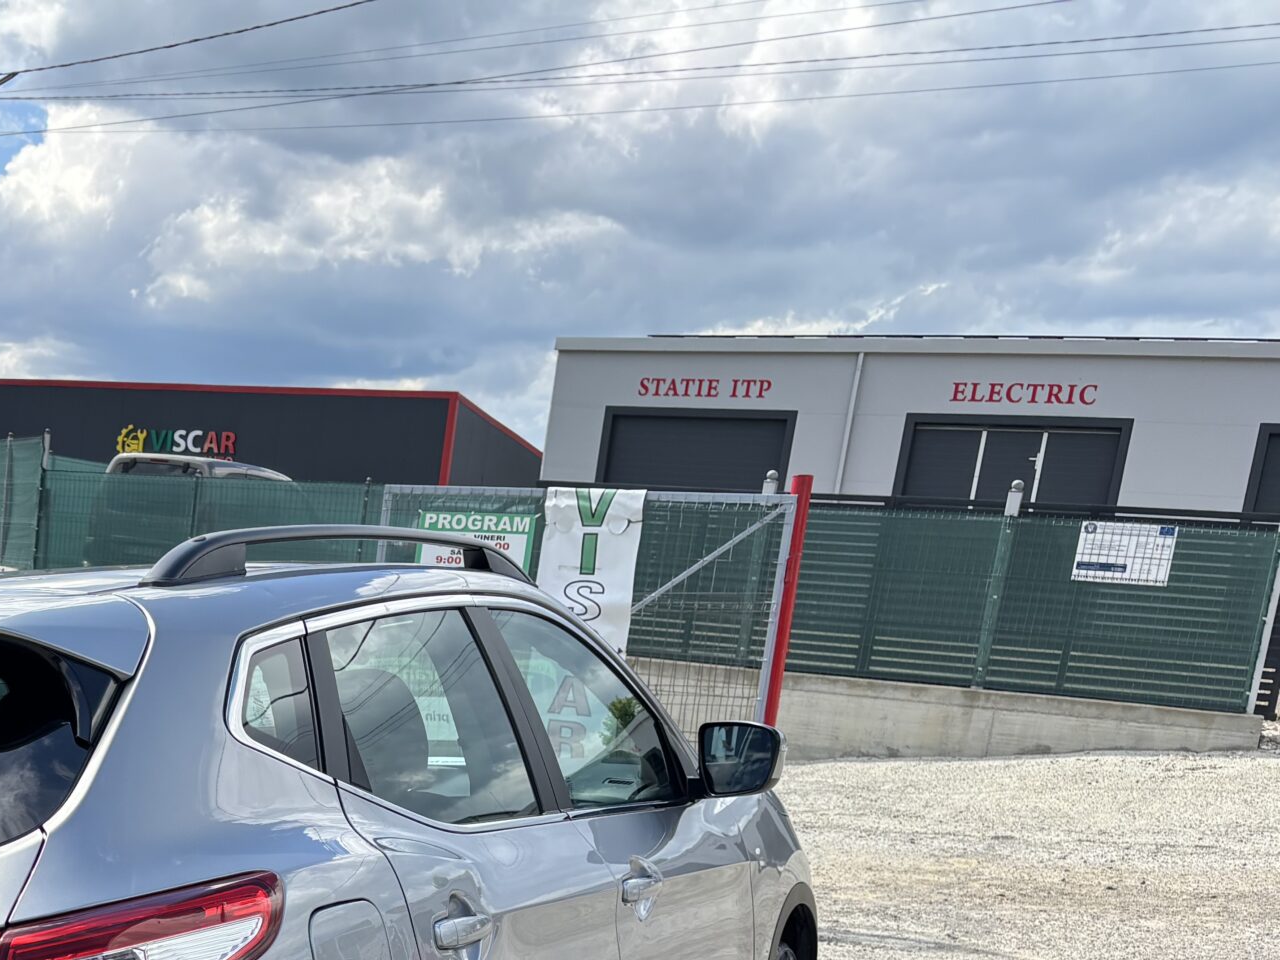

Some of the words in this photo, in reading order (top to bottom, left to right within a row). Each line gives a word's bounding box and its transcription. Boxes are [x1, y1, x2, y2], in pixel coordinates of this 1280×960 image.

[638, 377, 720, 397] STATIE
[729, 379, 772, 398] ITP
[949, 382, 1098, 405] ELECTRIC
[150, 429, 236, 454] VISCAR
[424, 513, 531, 533] PROGRAM
[435, 555, 462, 564] 9:00
